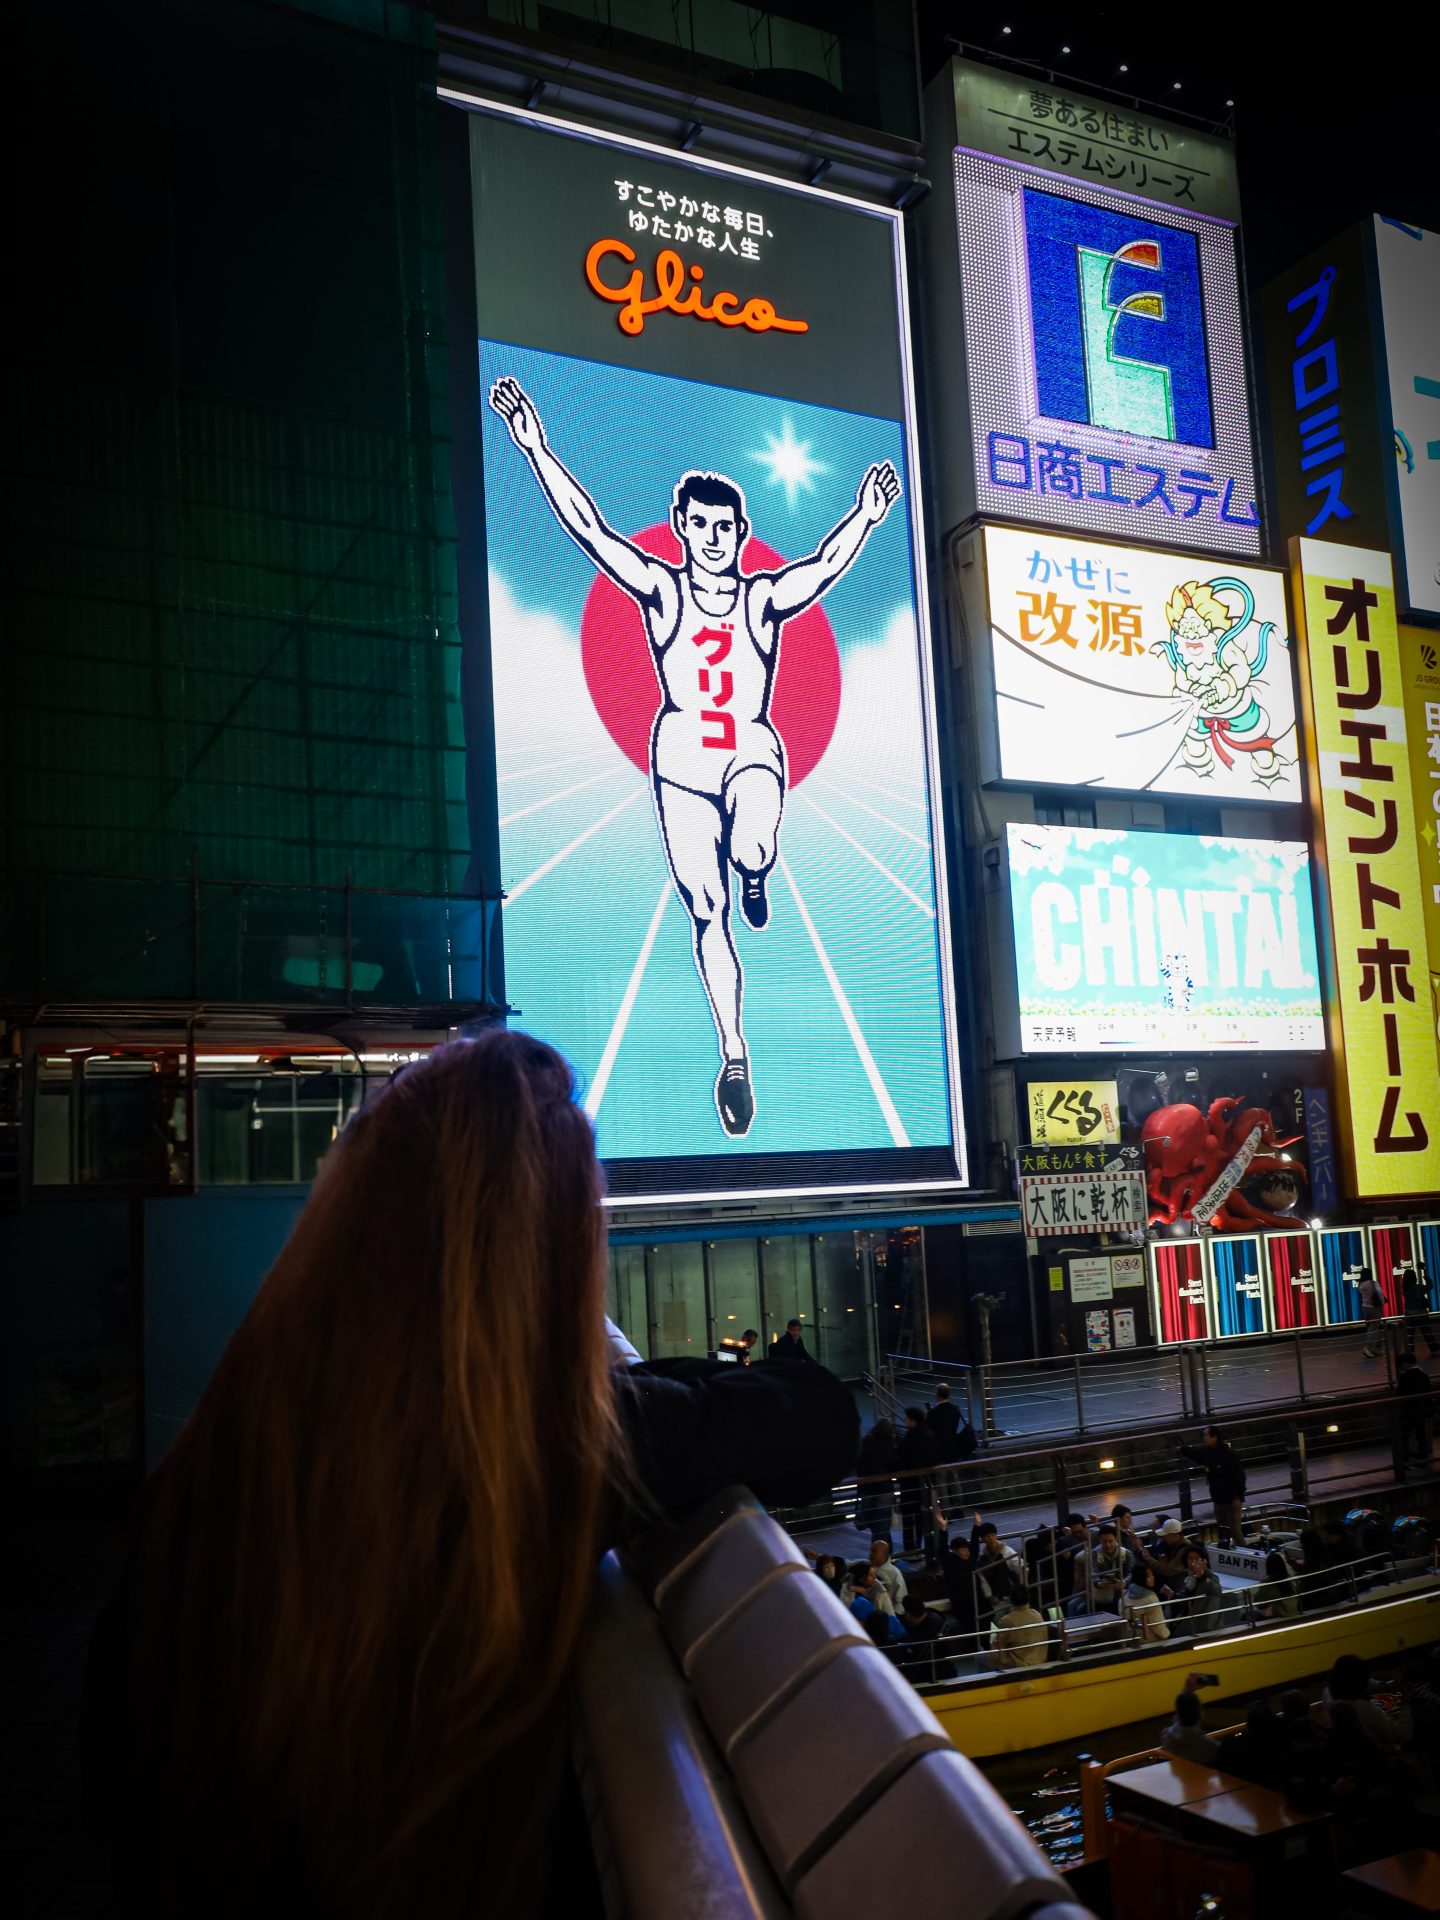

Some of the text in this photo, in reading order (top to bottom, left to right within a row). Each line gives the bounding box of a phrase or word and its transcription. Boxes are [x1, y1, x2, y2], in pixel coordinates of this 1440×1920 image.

[1029, 89, 1169, 152] 夢ある住まい
[1008, 126, 1196, 202] エステムシリーズ
[614, 179, 774, 239] すこやかな毎日、
[628, 209, 761, 262] ゆたかな人生
[585, 238, 809, 336] Glico
[1287, 265, 1354, 537] プロミス
[987, 431, 1262, 527] 日商エステム
[1026, 549, 1132, 595] かぜに
[1015, 590, 1146, 657] 改源
[691, 622, 737, 750] グリコ
[1324, 578, 1429, 1154] オリエントホーム
[1021, 1151, 1109, 1171] 大阪もんを食す
[1030, 1182, 1130, 1225] 大阪に乾杯
[1218, 1554, 1258, 1570] BAN PR
